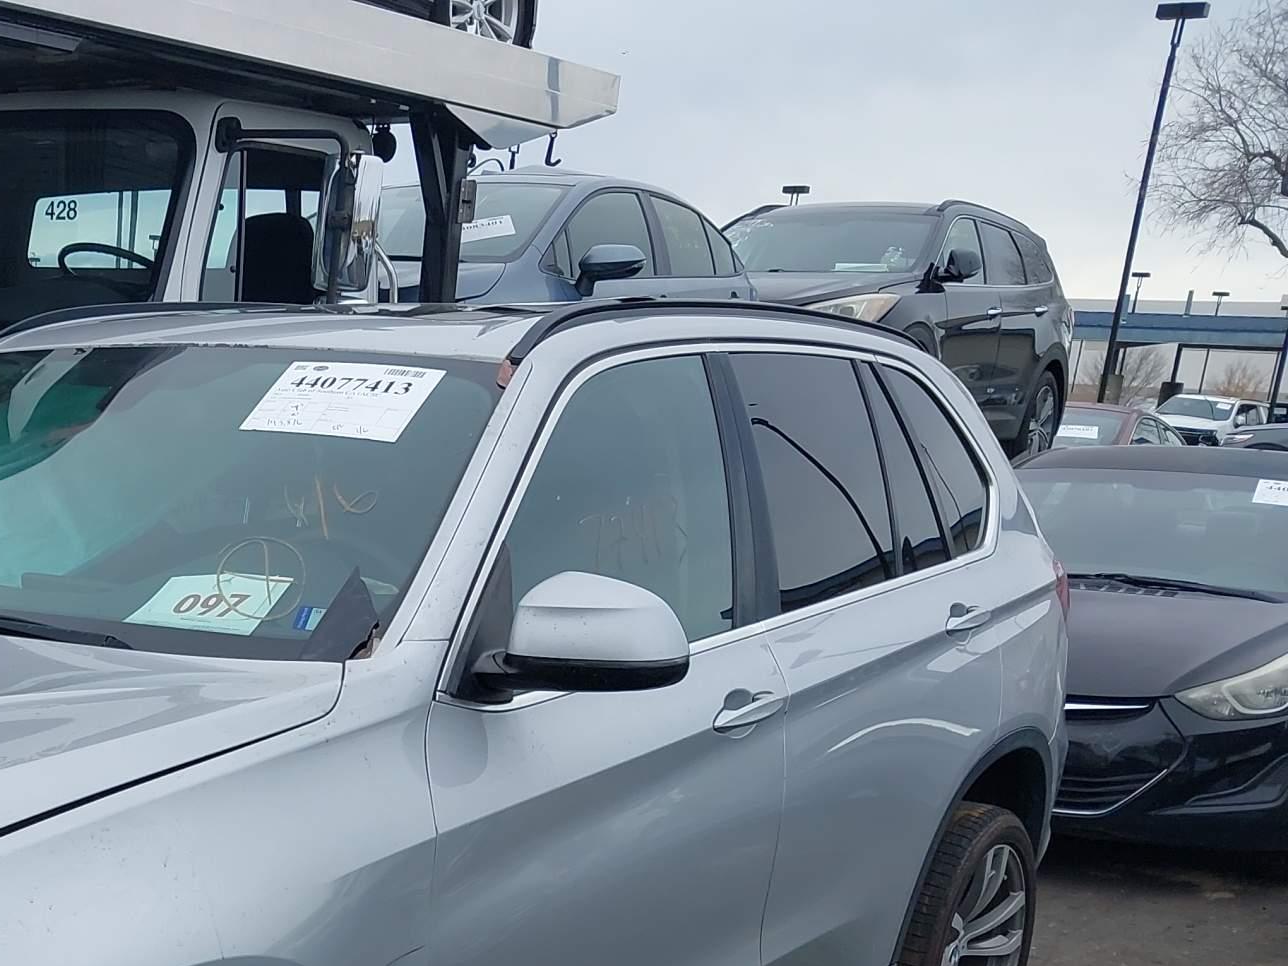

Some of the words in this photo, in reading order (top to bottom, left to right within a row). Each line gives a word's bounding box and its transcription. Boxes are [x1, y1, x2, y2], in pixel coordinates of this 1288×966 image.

[45, 200, 77, 221] 428
[291, 375, 413, 395] 44077413
[173, 593, 251, 617] 097
